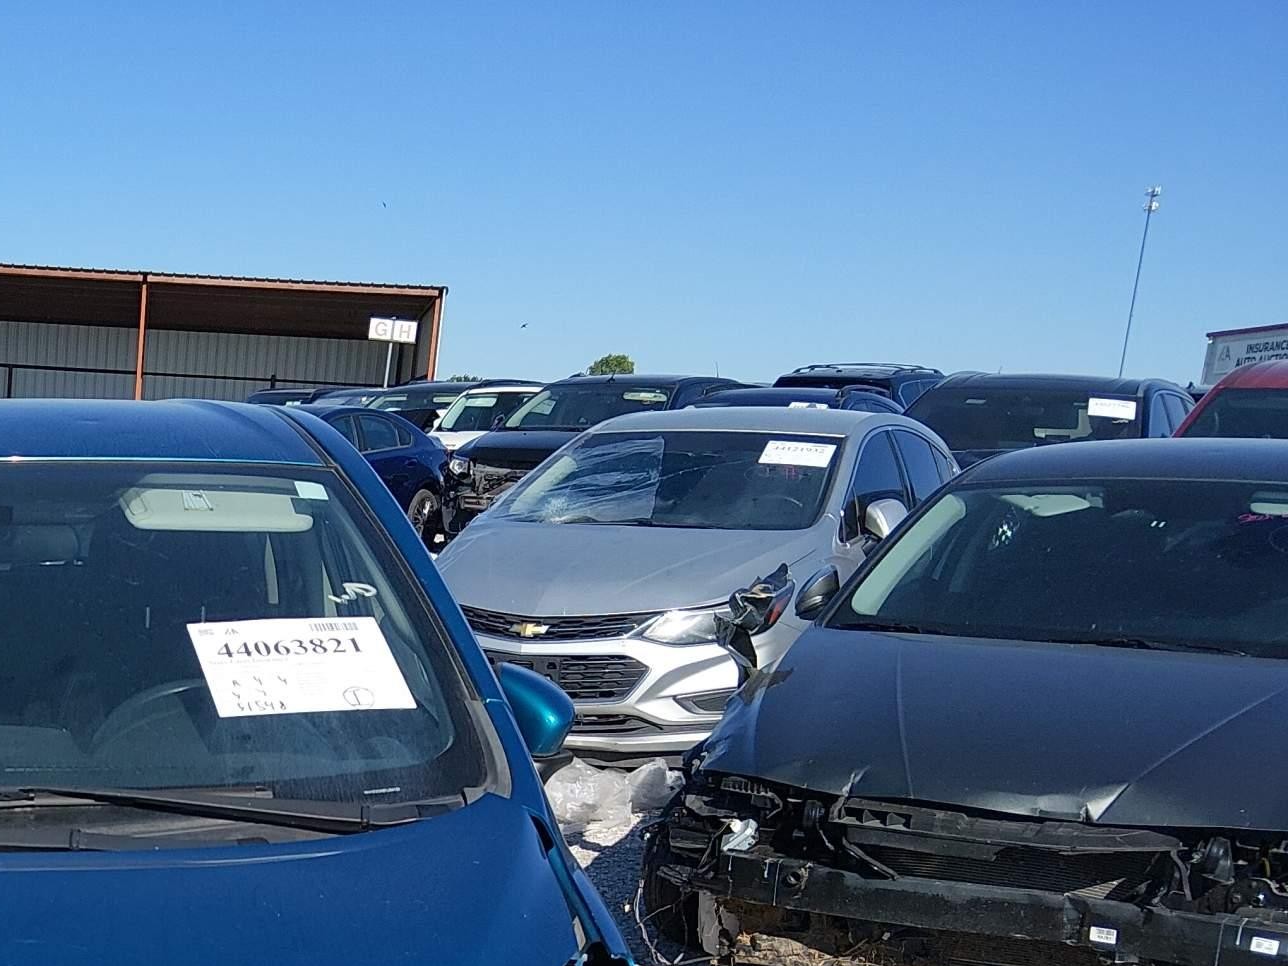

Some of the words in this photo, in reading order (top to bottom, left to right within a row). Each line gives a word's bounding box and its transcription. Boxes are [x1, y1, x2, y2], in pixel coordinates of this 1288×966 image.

[375, 322, 388, 336] G
[399, 325, 412, 338] H
[217, 637, 363, 658] 44063821
